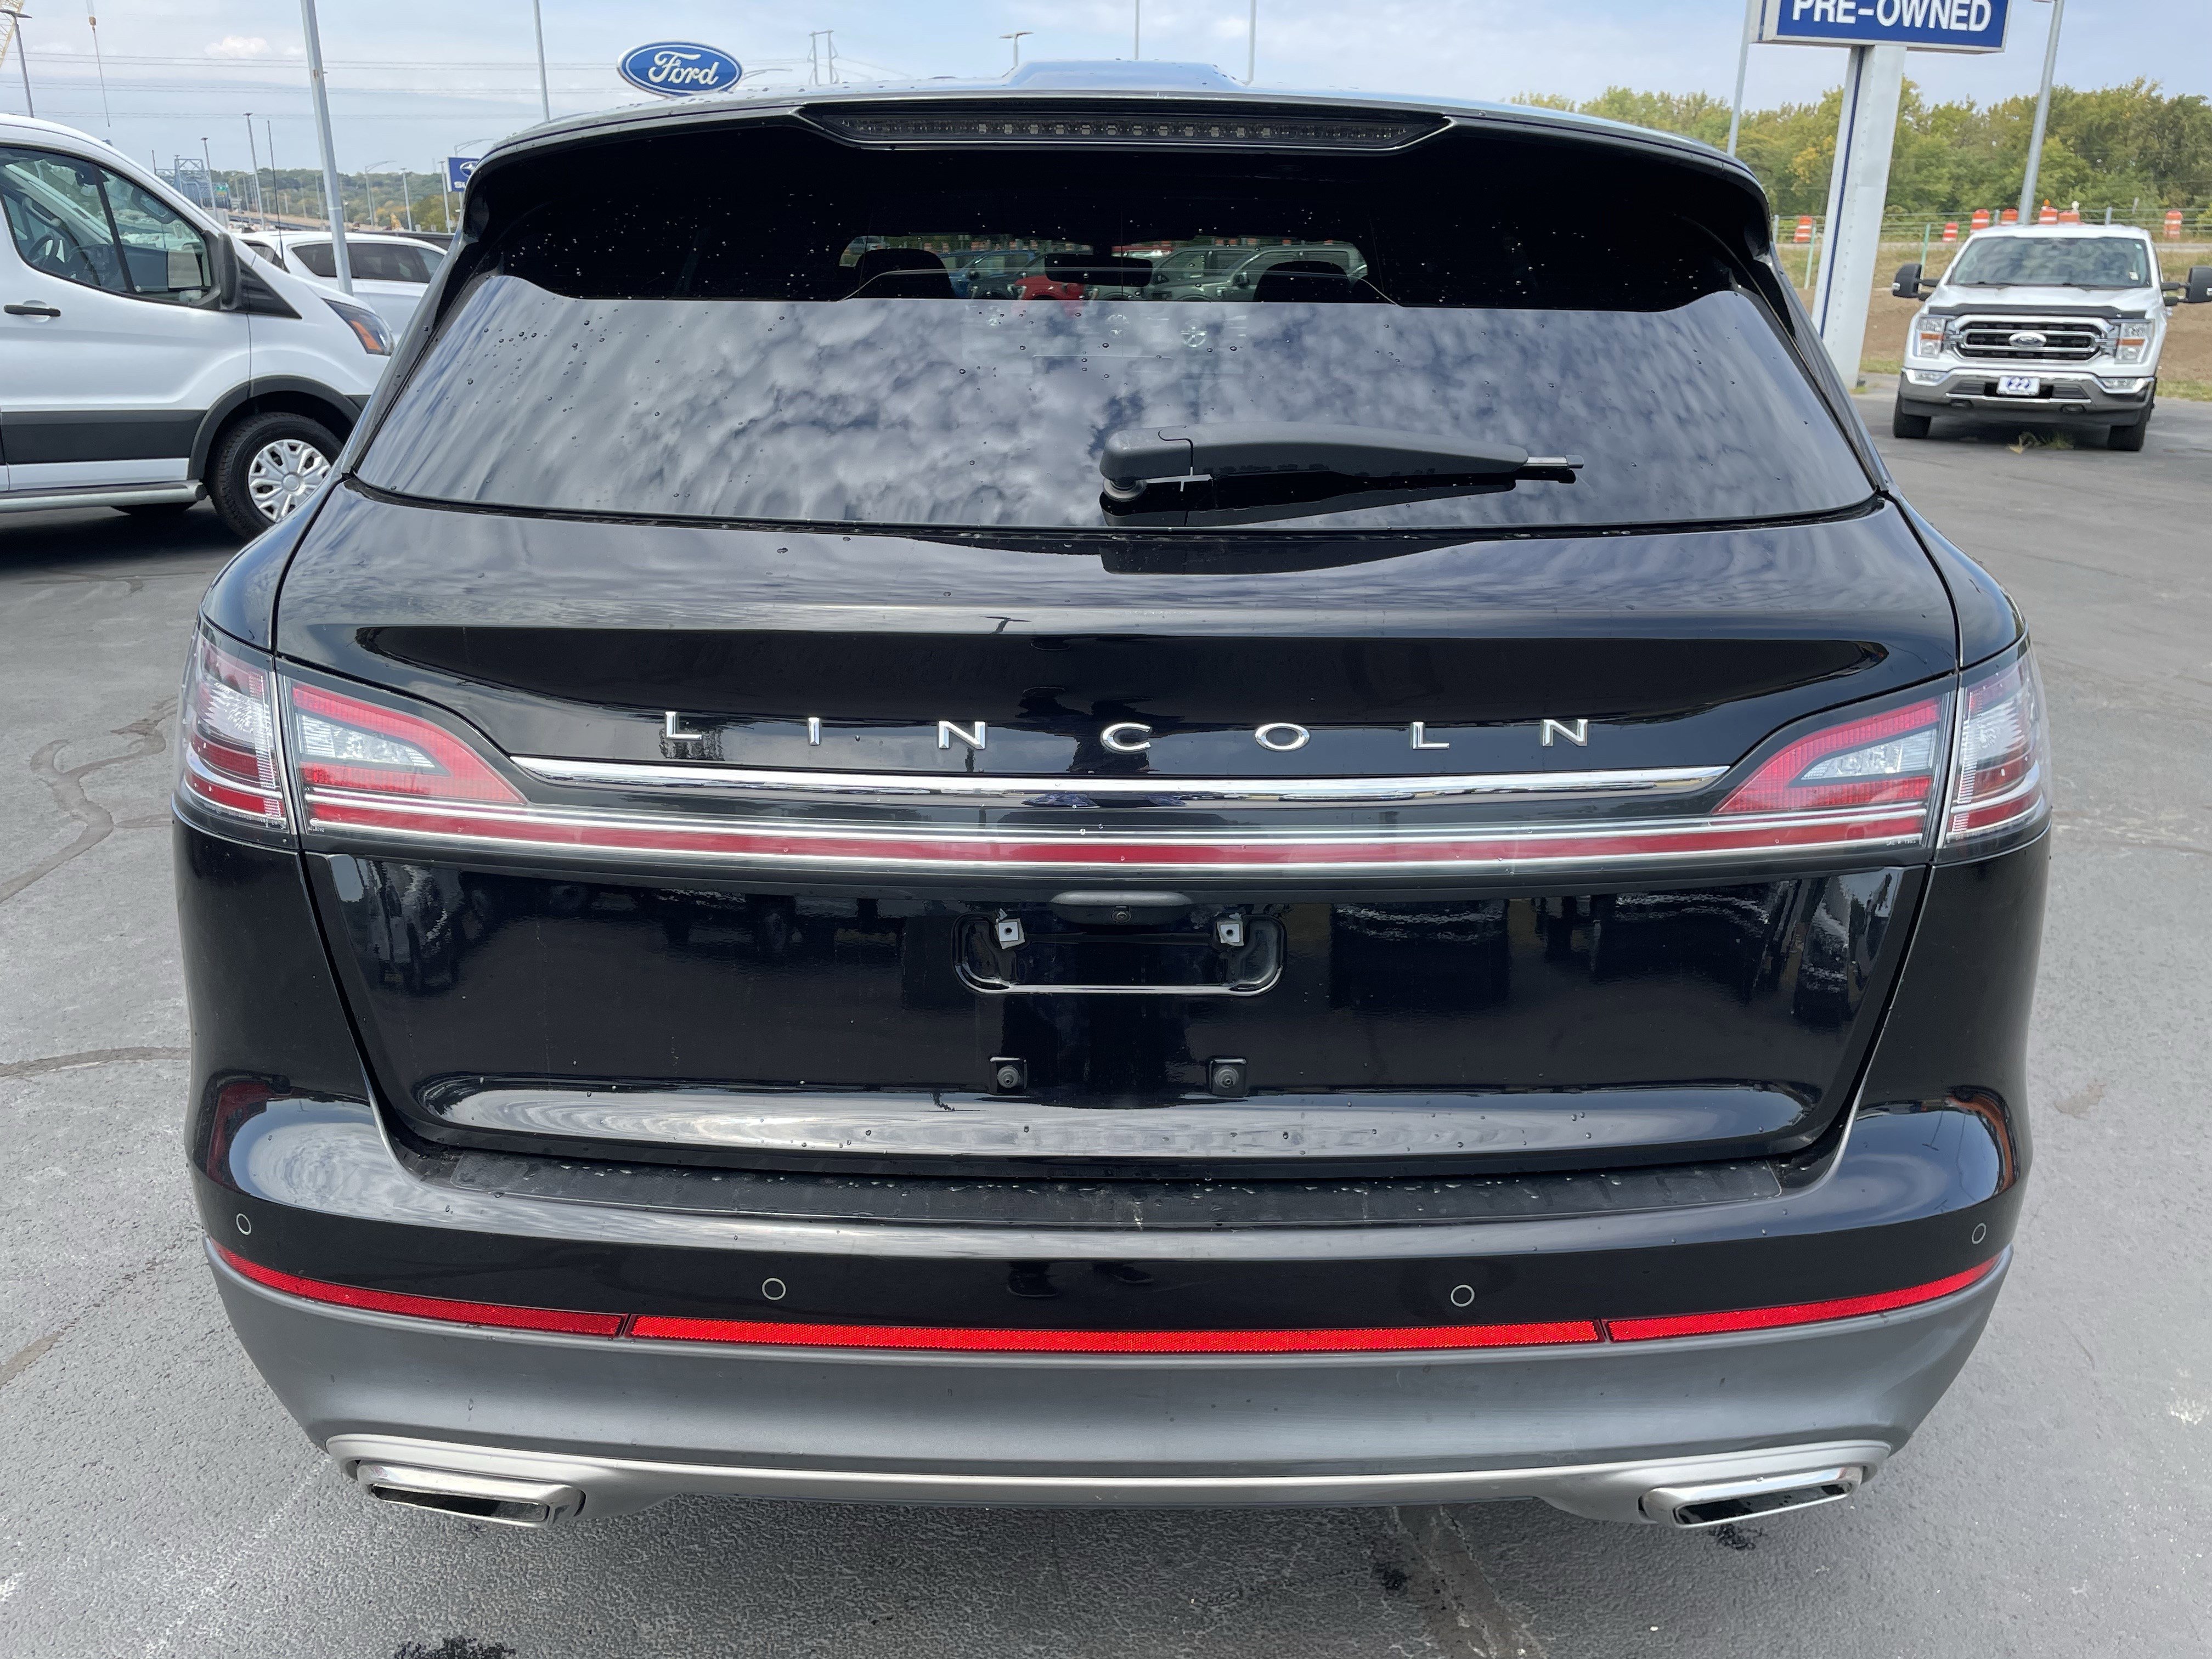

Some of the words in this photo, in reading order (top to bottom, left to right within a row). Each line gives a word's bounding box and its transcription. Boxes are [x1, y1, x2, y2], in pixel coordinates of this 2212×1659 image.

[1792, 0, 1992, 32] PRE-OWNED
[648, 50, 720, 85] Ford
[664, 710, 1589, 752] LINCOLN
